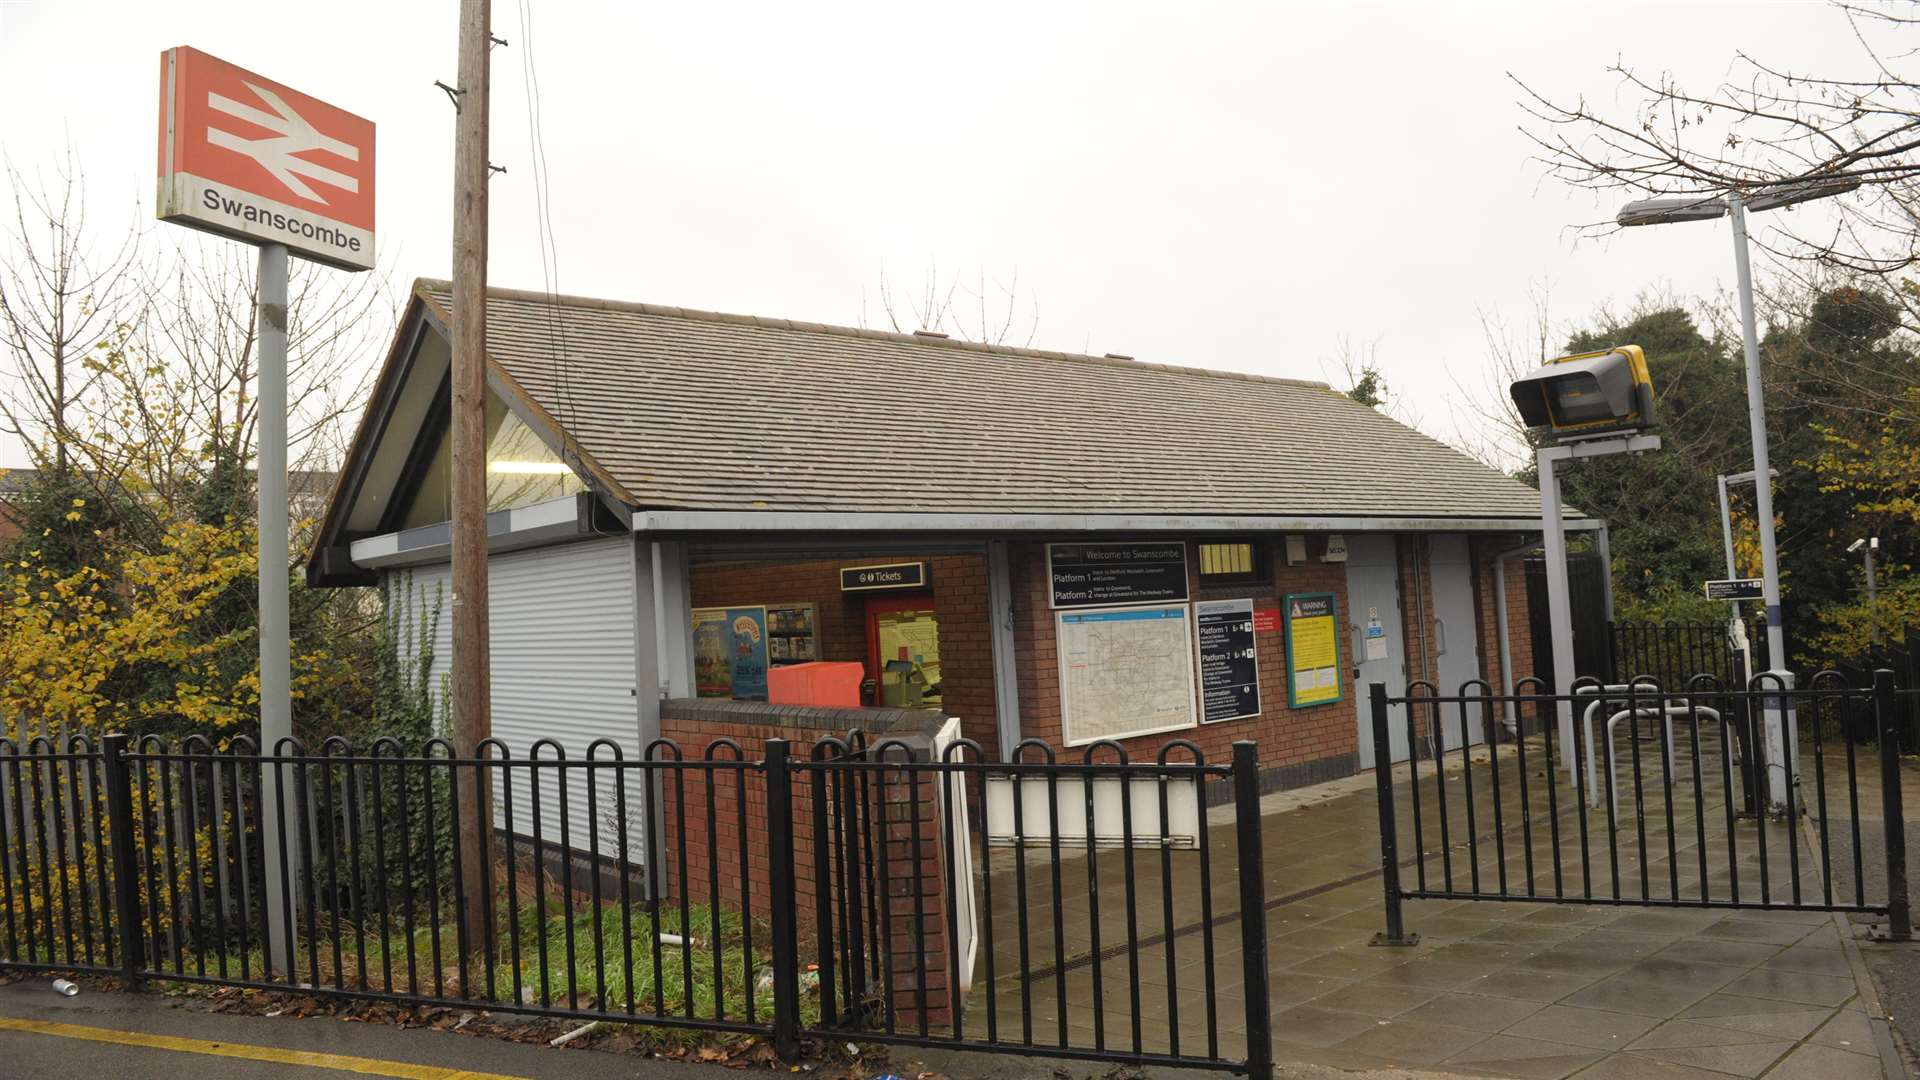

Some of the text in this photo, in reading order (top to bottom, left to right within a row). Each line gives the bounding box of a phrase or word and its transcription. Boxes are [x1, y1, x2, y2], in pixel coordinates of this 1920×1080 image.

[203, 188, 361, 252] Swanscombe
[1086, 551, 1121, 560] Welcome
[1122, 551, 1132, 559] to
[1132, 549, 1180, 559] Swanscombe
[875, 570, 902, 582] Tickets
[1053, 573, 1086, 583] Platform
[1088, 573, 1092, 581] 1
[1054, 589, 1093, 601] Platform 2
[1302, 600, 1327, 610] WARNING
[1200, 626, 1223, 635] Platform
[1201, 654, 1225, 662] Platform
